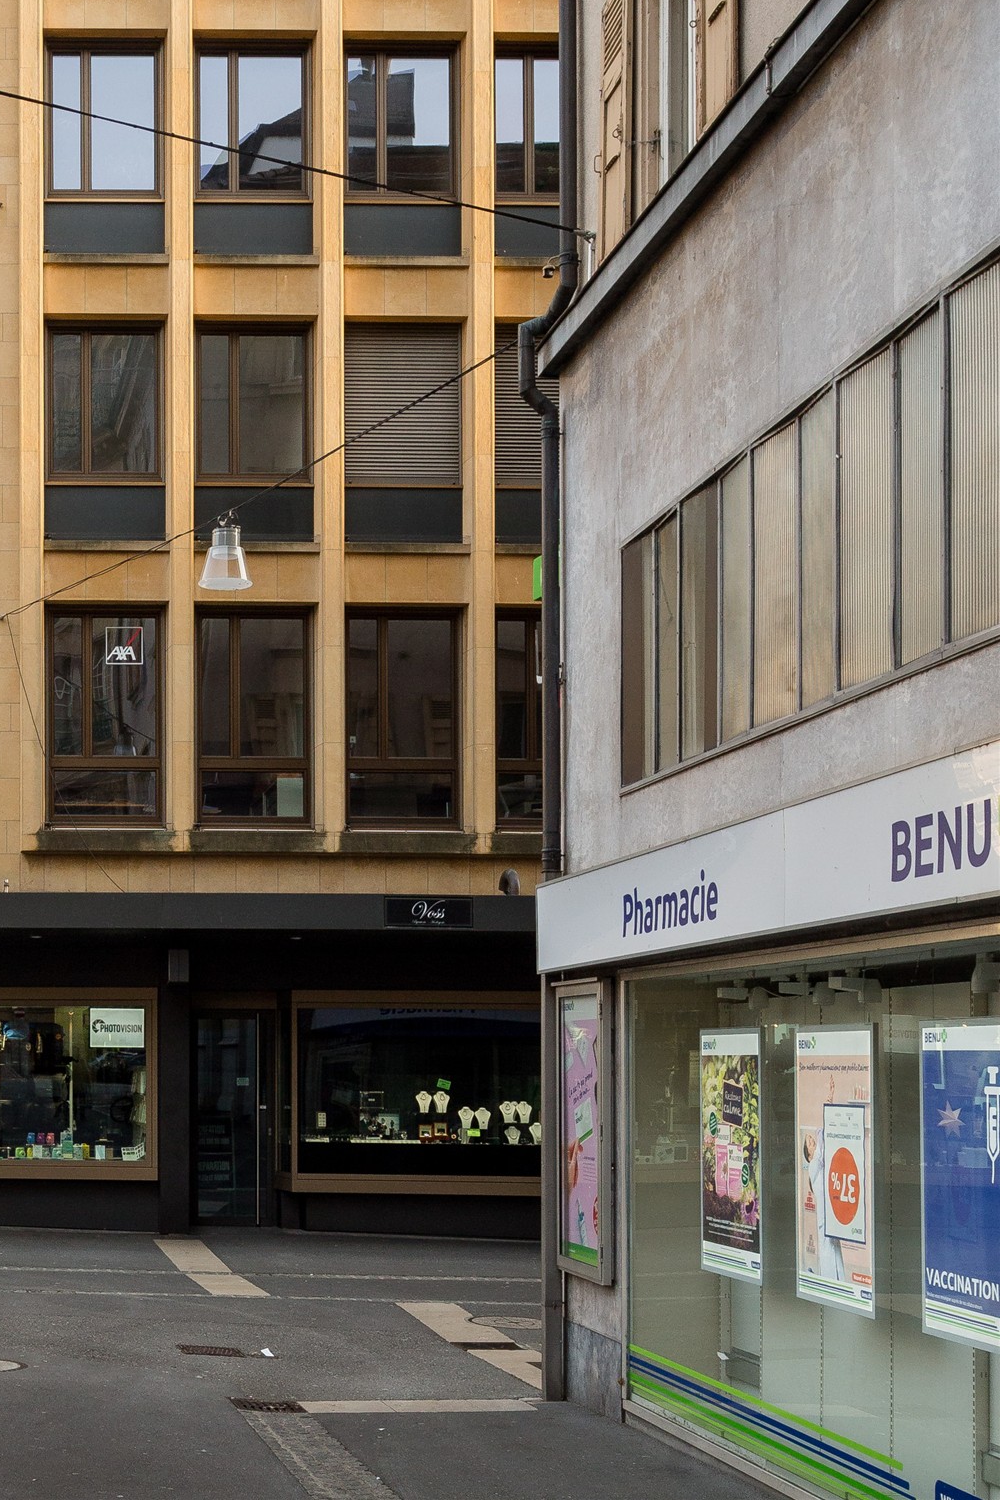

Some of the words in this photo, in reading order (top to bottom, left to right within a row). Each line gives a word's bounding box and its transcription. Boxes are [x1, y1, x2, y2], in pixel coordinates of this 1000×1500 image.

[106, 646, 136, 660] AXA
[891, 798, 992, 883] BENU
[411, 899, 446, 920] Voss
[622, 869, 719, 938] Pharmacie
[100, 1024, 143, 1033] PHOTOVISION
[798, 1040, 811, 1049] BENU
[924, 1032, 941, 1043] BENU
[926, 1266, 1000, 1302] VACCINATION
